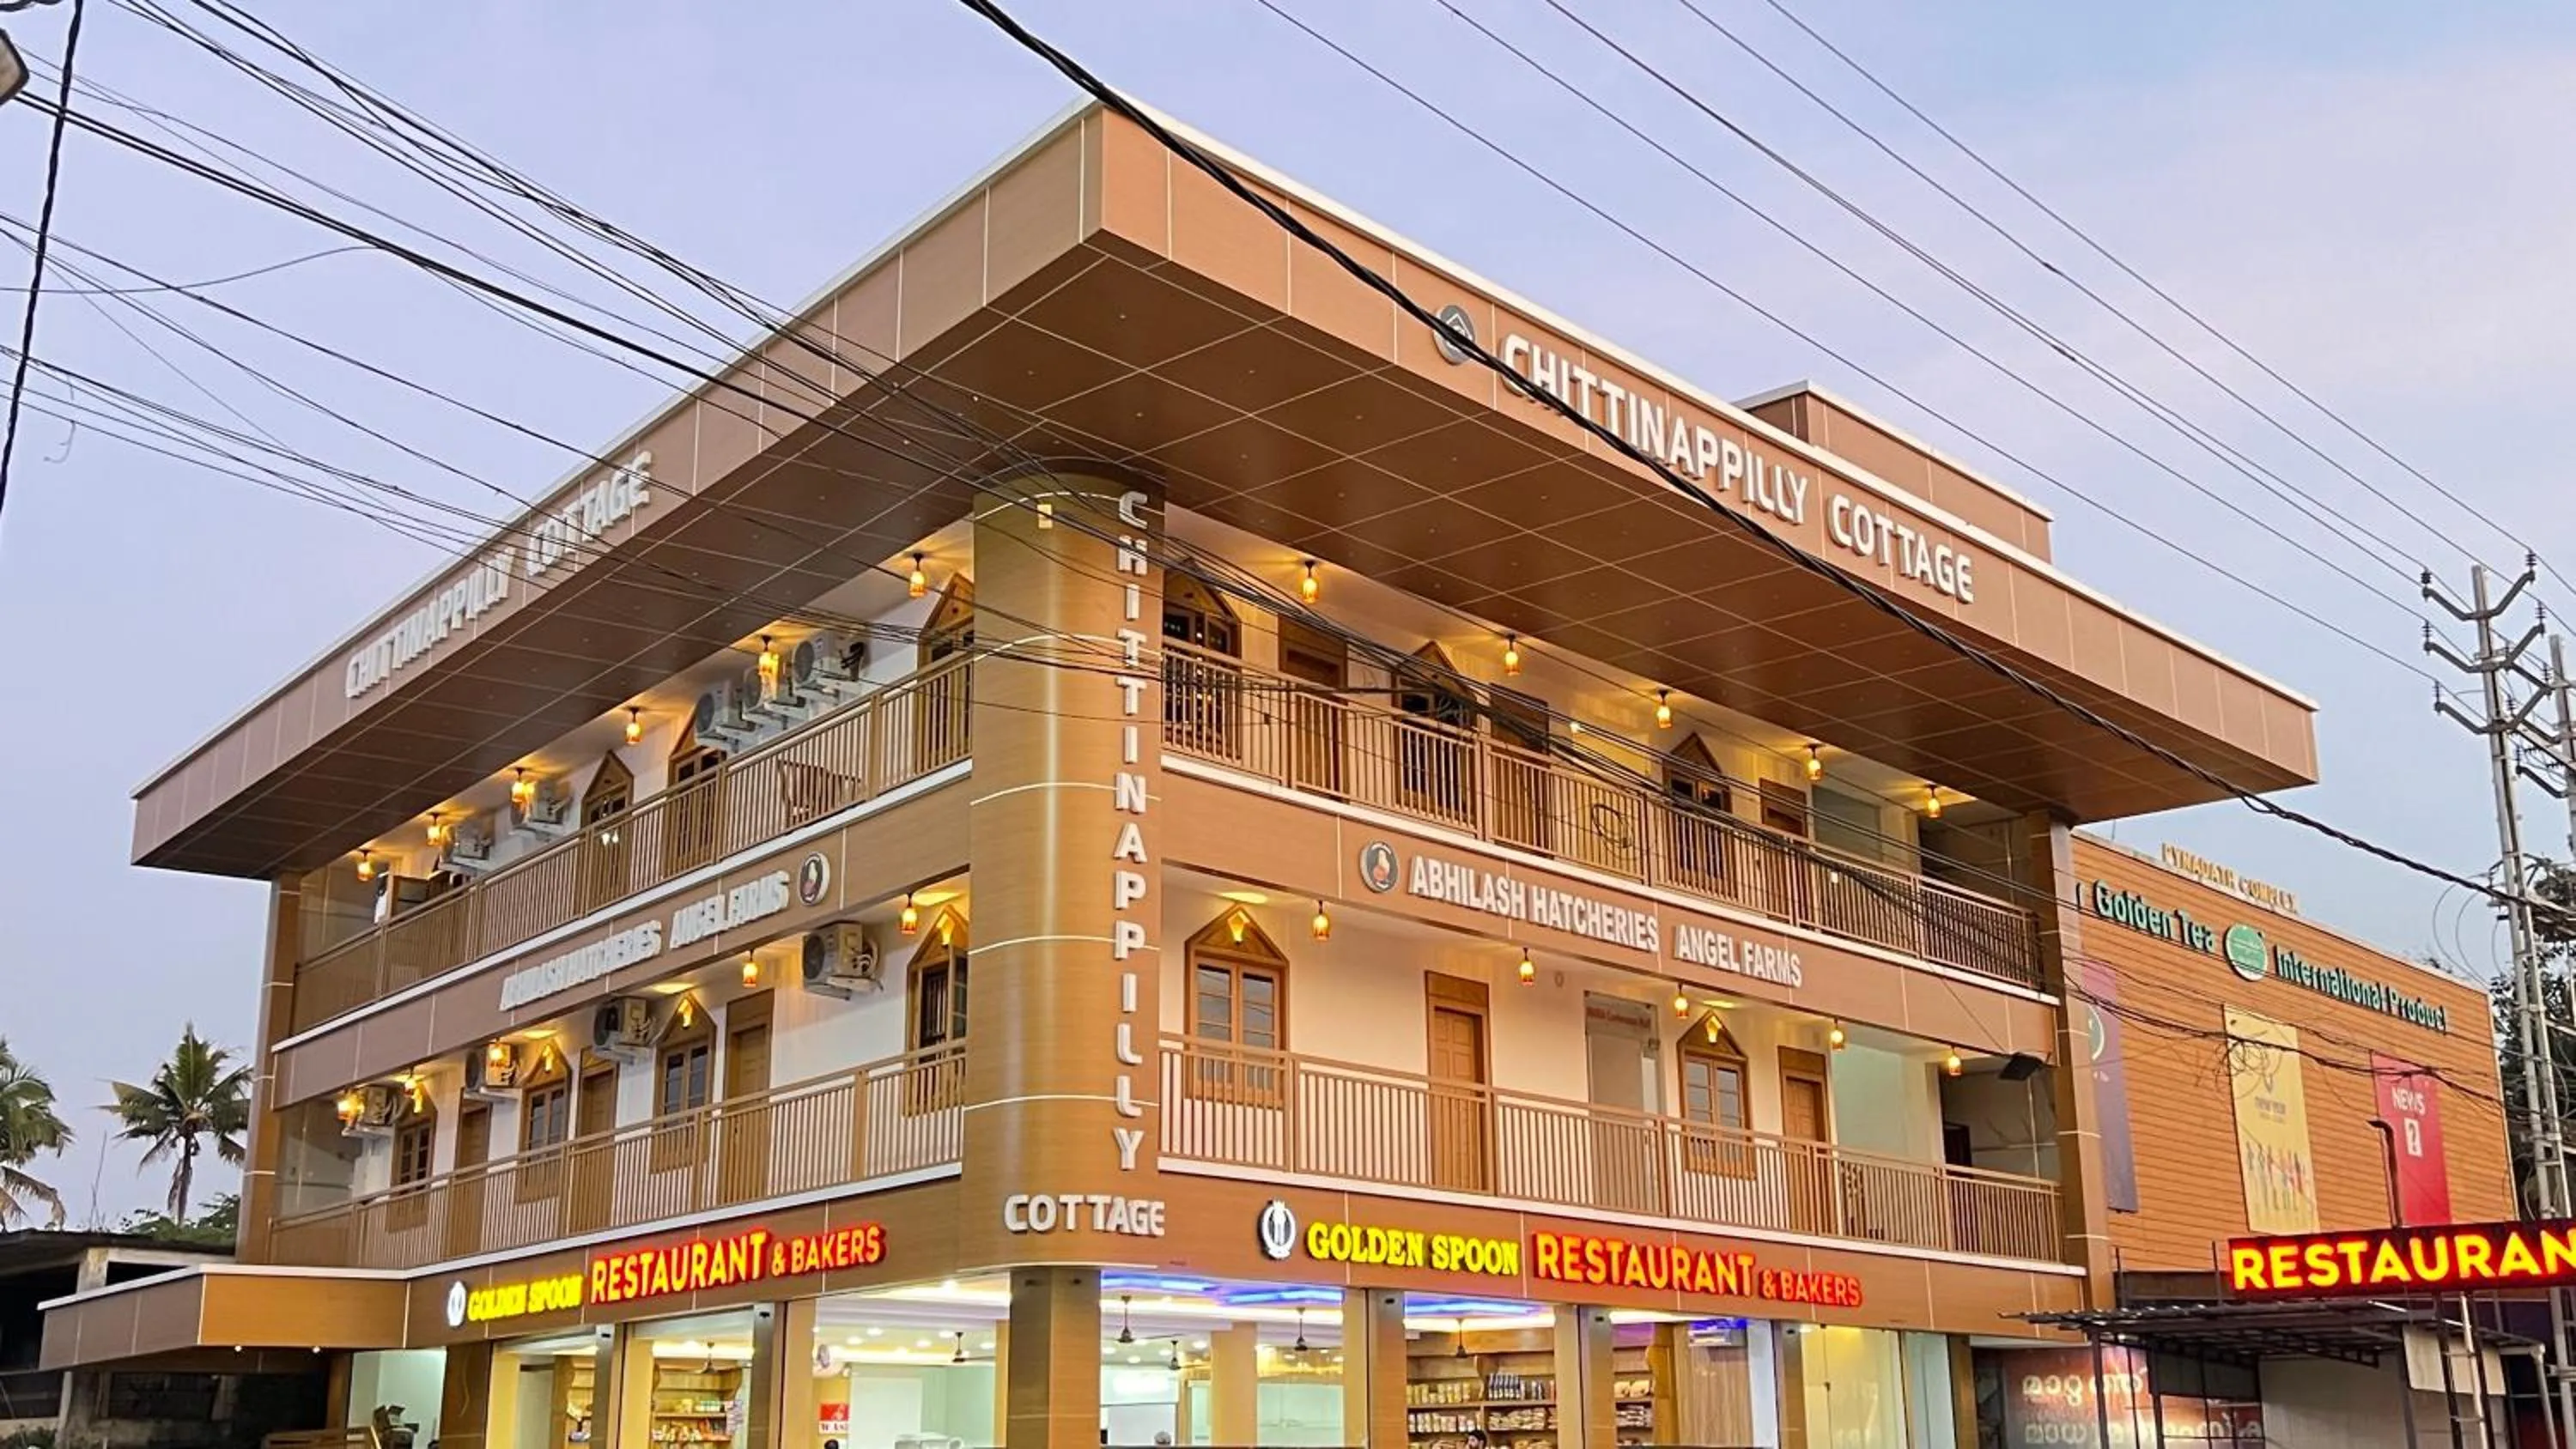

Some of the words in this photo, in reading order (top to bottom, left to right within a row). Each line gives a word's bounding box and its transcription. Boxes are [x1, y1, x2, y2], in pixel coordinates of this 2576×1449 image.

[1499, 333, 1808, 525] CHITTINAPPILLY
[1826, 493, 1974, 603] COTTAGE
[526, 451, 653, 577] COTTAGE
[1408, 855, 1527, 919] ABHILASH
[1528, 886, 1661, 954] HATCHERIES
[1674, 925, 1741, 973] ANGEL
[1741, 939, 1802, 989] FARMS
[2093, 879, 2173, 939] Golden
[2173, 908, 2217, 955] Tea
[2273, 943, 2386, 1013] International
[1003, 1193, 1166, 1237] COTTAGE
[466, 1282, 528, 1322] GOLDEN
[527, 1274, 584, 1314] SPOON
[589, 1228, 770, 1305] RESTAURANT
[771, 1240, 787, 1278] &
[789, 1224, 887, 1275] BAKERS
[1306, 1221, 1425, 1267] GOLDEN
[1431, 1234, 1520, 1276] SPOON
[1533, 1232, 1756, 1298] RESTAURANT
[1760, 1269, 1777, 1300] &
[1779, 1270, 1863, 1307] BAKERS
[2232, 1229, 2575, 1290] RESTAURAN
